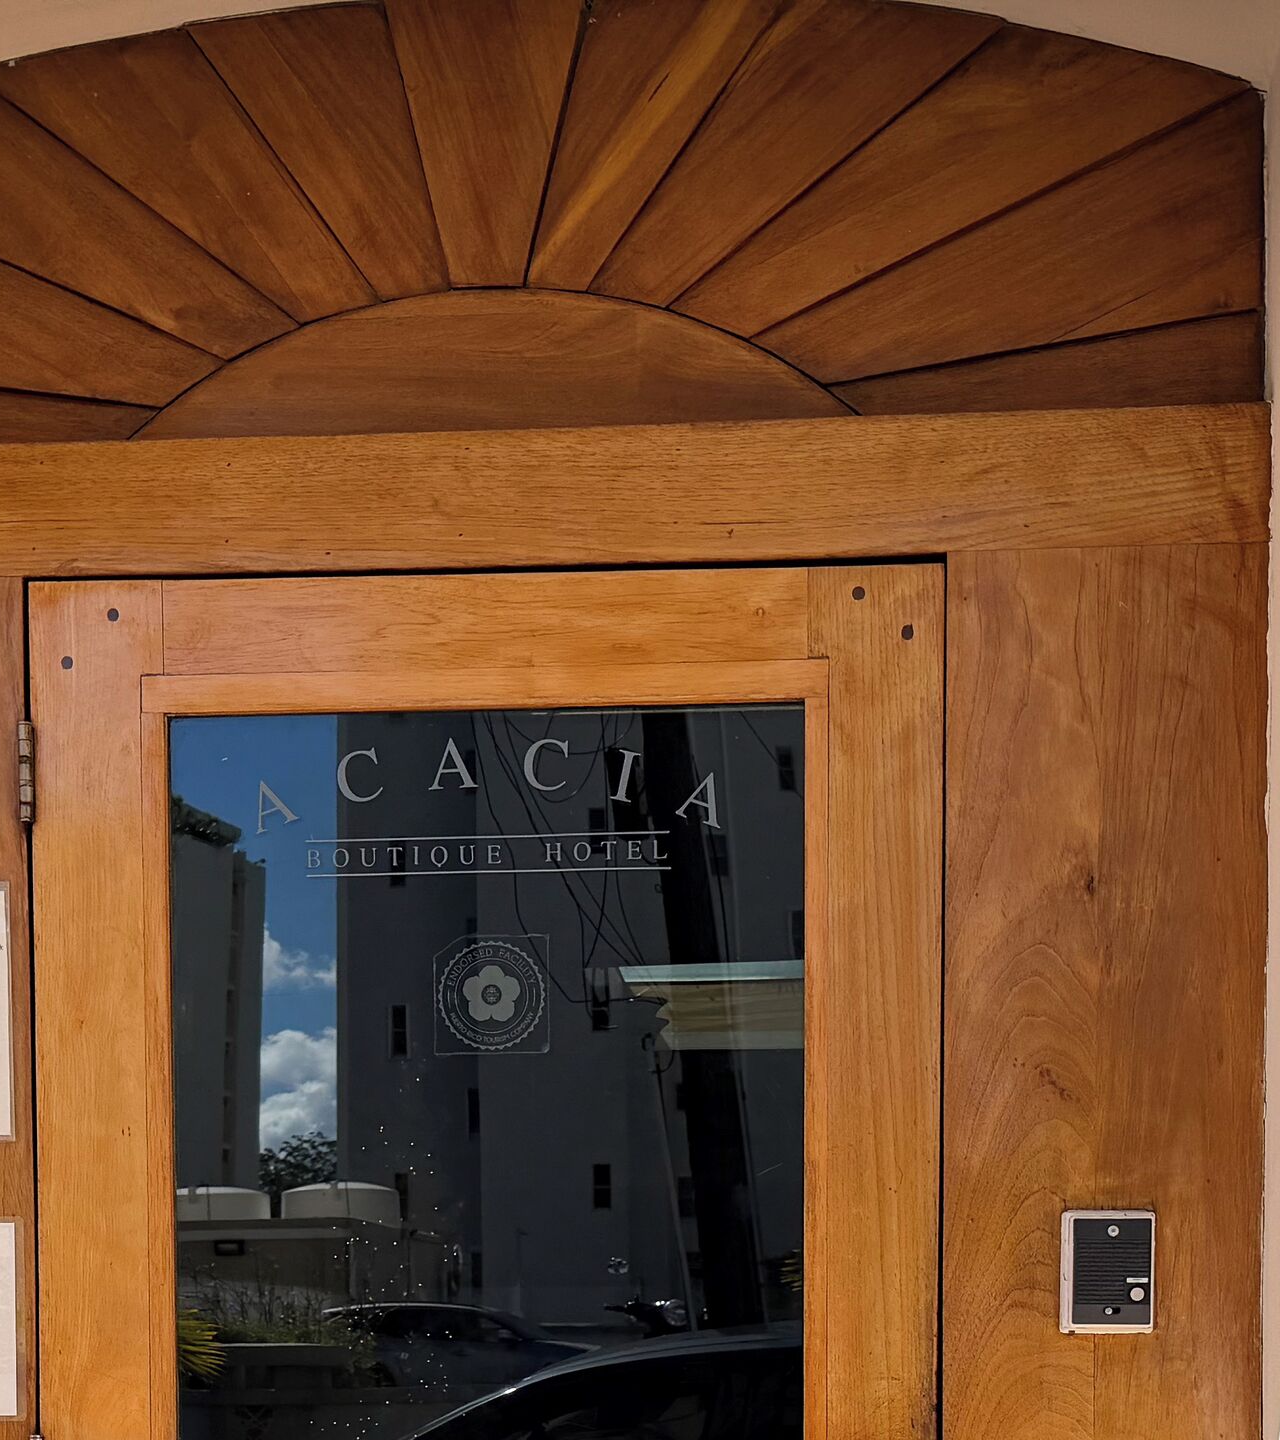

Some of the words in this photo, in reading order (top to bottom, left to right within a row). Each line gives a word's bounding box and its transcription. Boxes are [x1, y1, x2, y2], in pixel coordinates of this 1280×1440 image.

[256, 737, 720, 834] ACACIA
[307, 845, 502, 868] BOUTIQUE
[544, 840, 669, 863] HOTEL
[448, 948, 493, 986] ENDORSED
[499, 948, 537, 984] FACILITY
